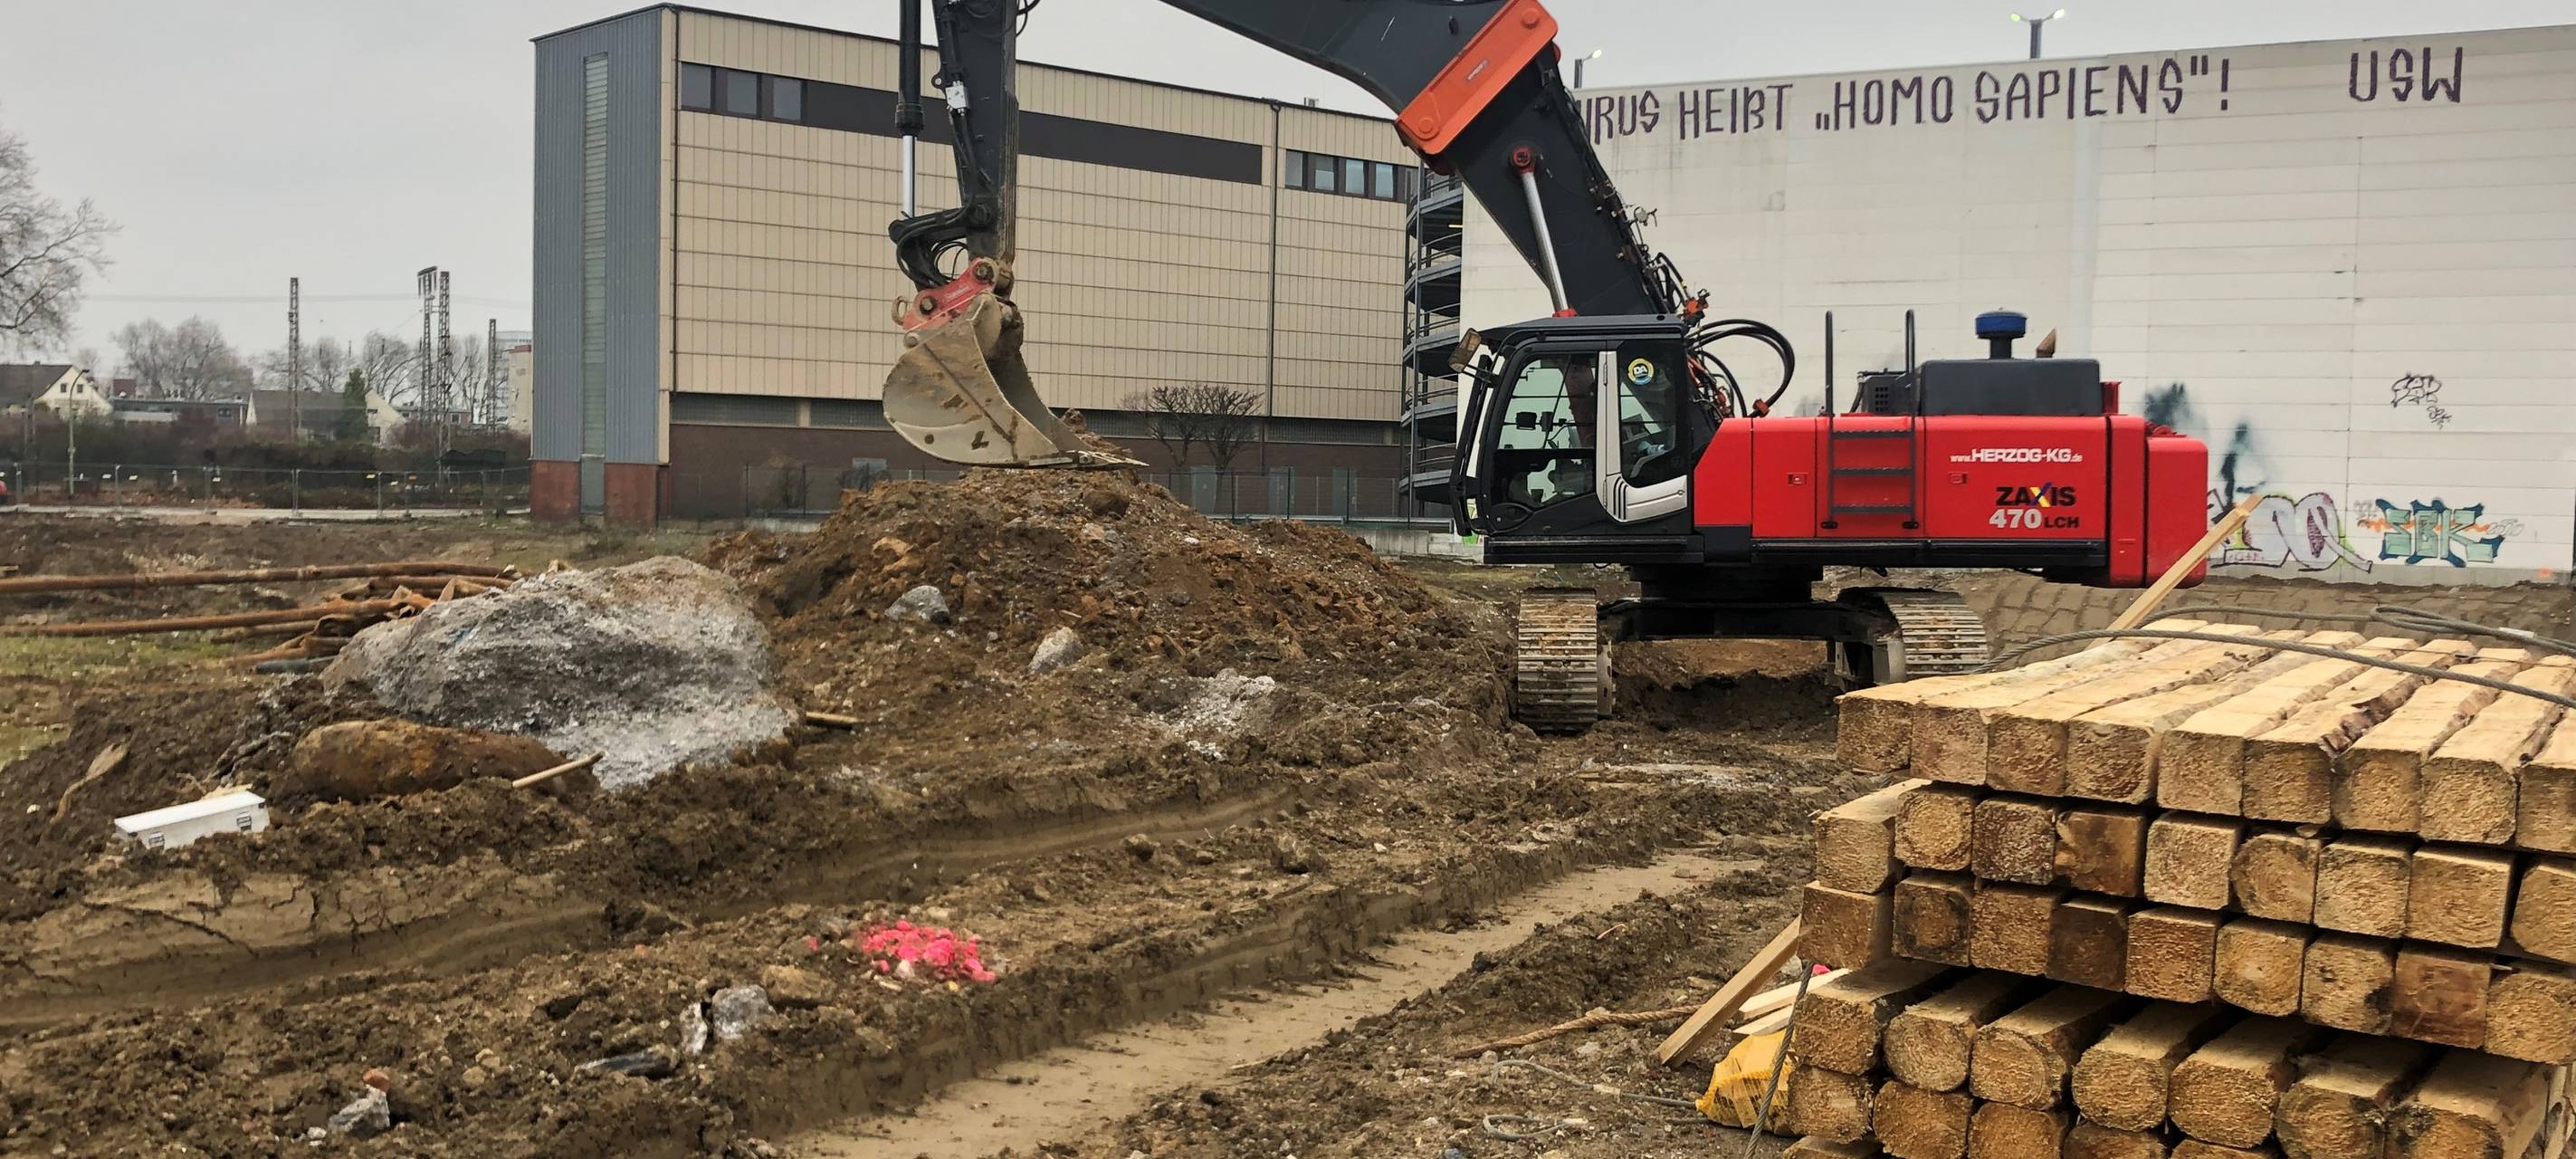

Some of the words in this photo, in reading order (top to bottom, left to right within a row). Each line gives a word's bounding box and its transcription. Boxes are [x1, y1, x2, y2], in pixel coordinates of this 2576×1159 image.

[1575, 90, 1660, 145] IRUS
[2349, 46, 2463, 103] USW
[1996, 482, 2076, 508] ZAXIS
[1989, 508, 2043, 529] 470
[2044, 516, 2079, 528] LCH
